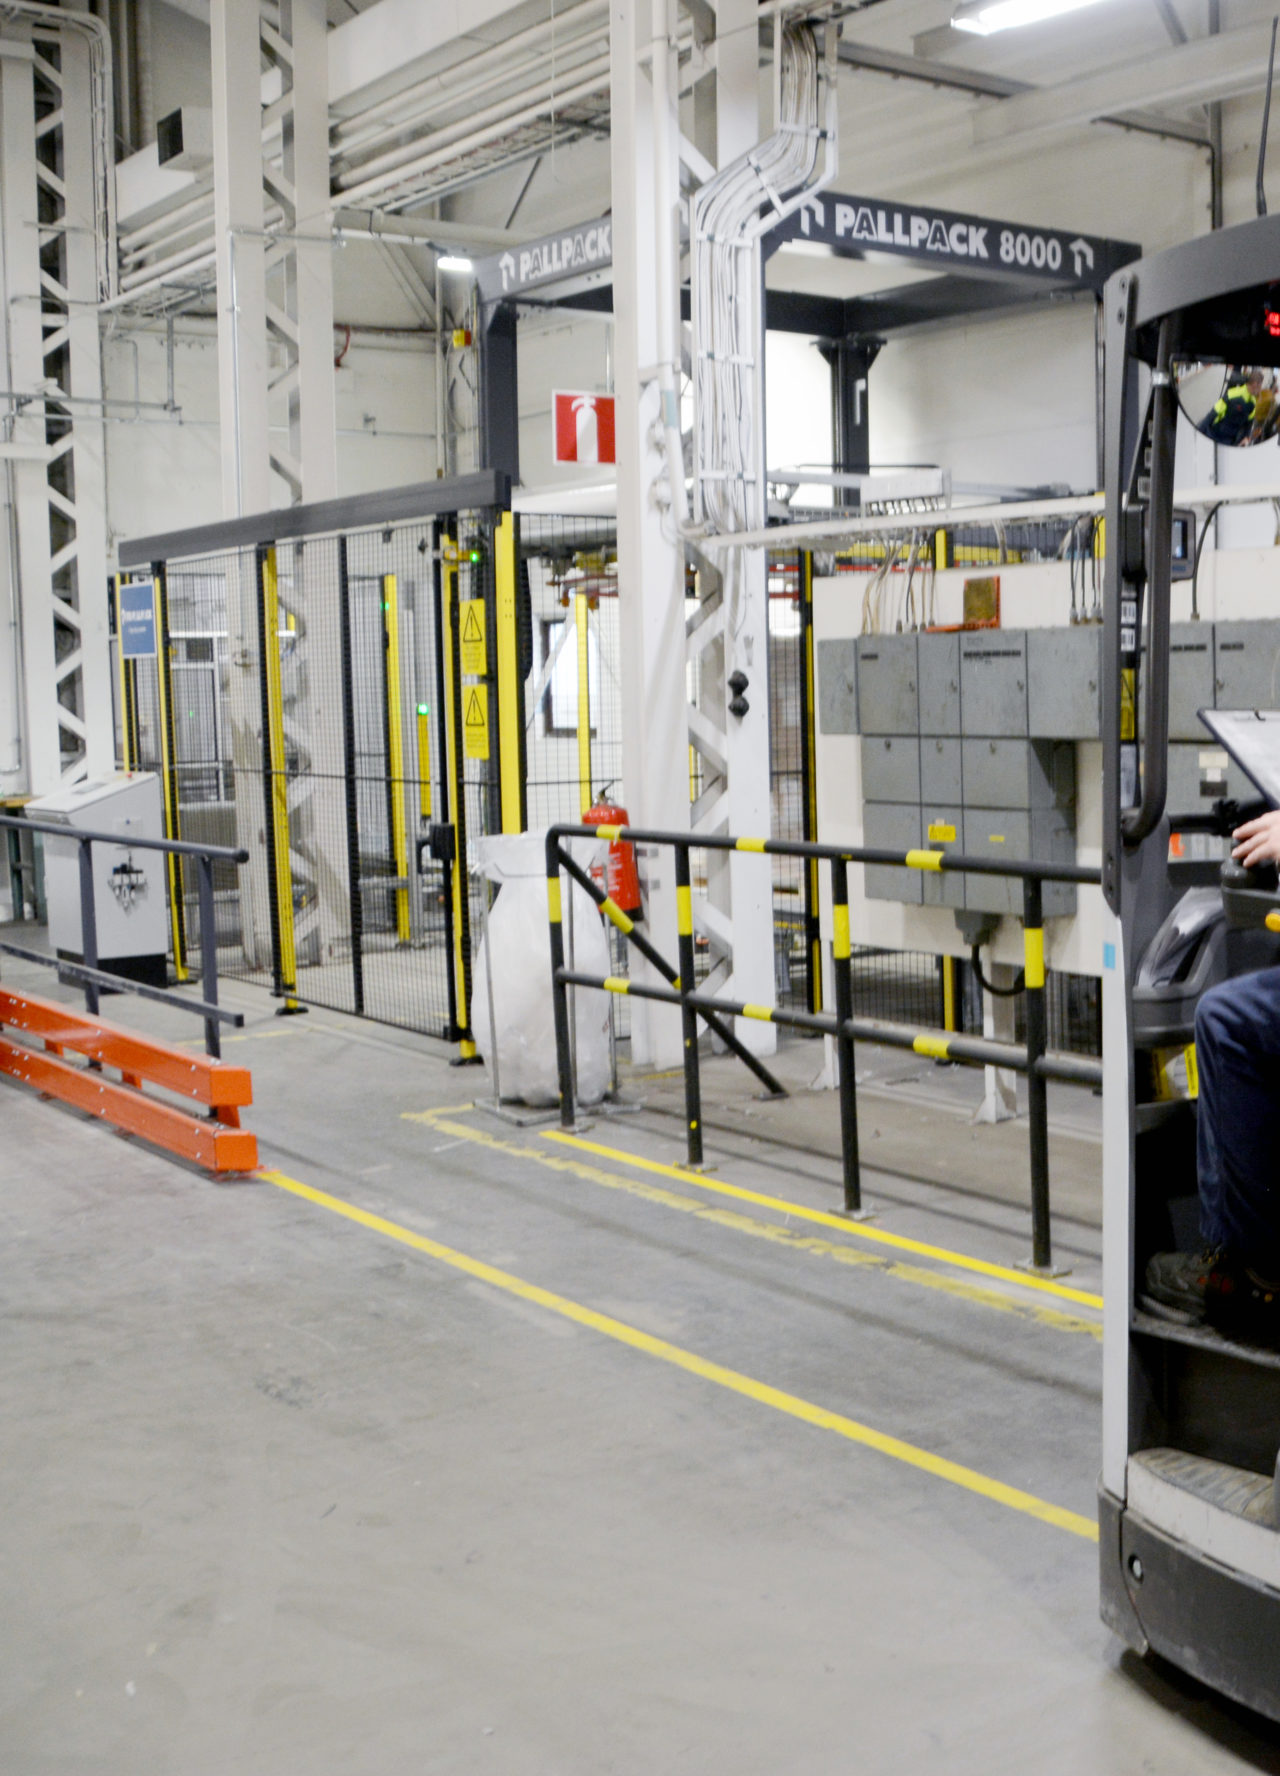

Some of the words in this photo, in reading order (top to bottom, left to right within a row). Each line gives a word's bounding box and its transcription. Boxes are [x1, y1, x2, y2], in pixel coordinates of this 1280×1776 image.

[519, 224, 611, 283] PALLPACK
[835, 202, 989, 259] PALLPACK
[1000, 229, 1062, 271] 8000
